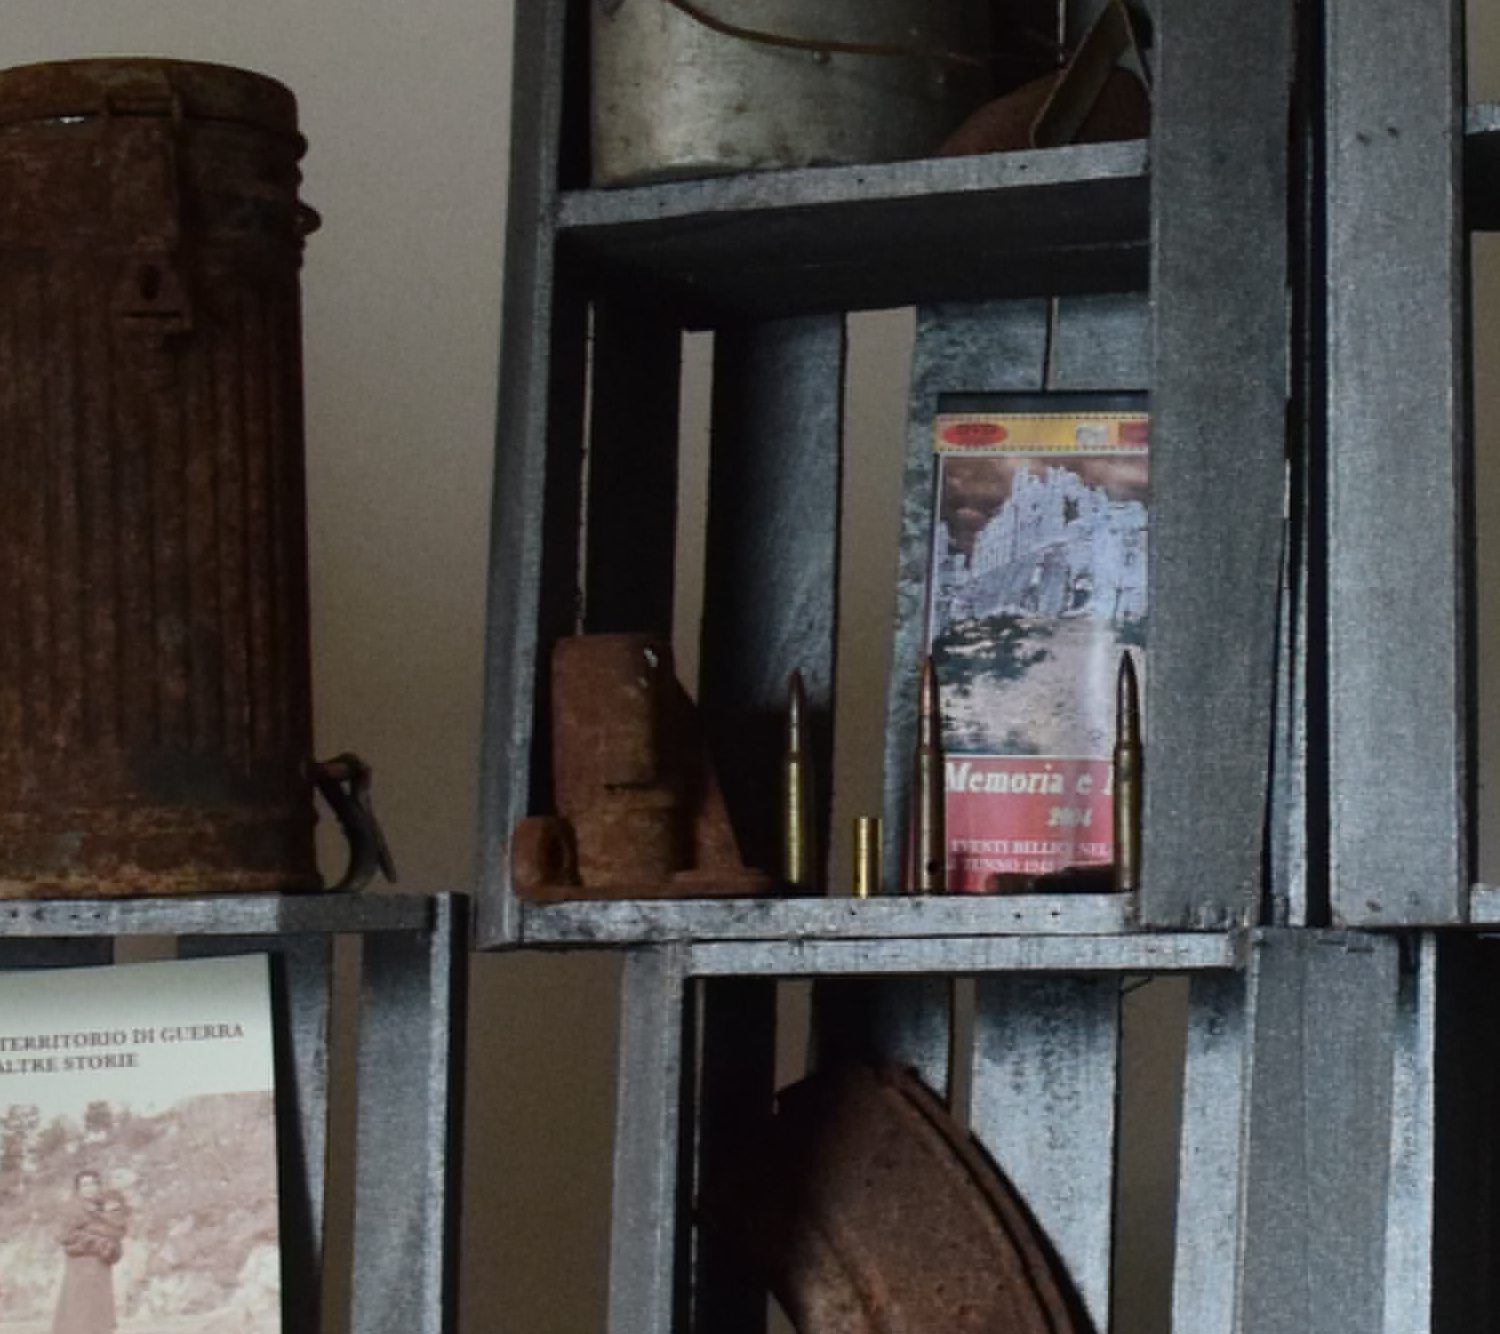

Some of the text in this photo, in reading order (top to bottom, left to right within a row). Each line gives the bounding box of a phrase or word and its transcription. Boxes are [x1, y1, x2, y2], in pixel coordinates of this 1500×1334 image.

[945, 762, 1063, 794] Memoria
[1076, 772, 1093, 794] e
[132, 1028, 155, 1044] DI
[160, 1023, 244, 1043] GUERRA
[64, 1052, 139, 1070] STORIE
